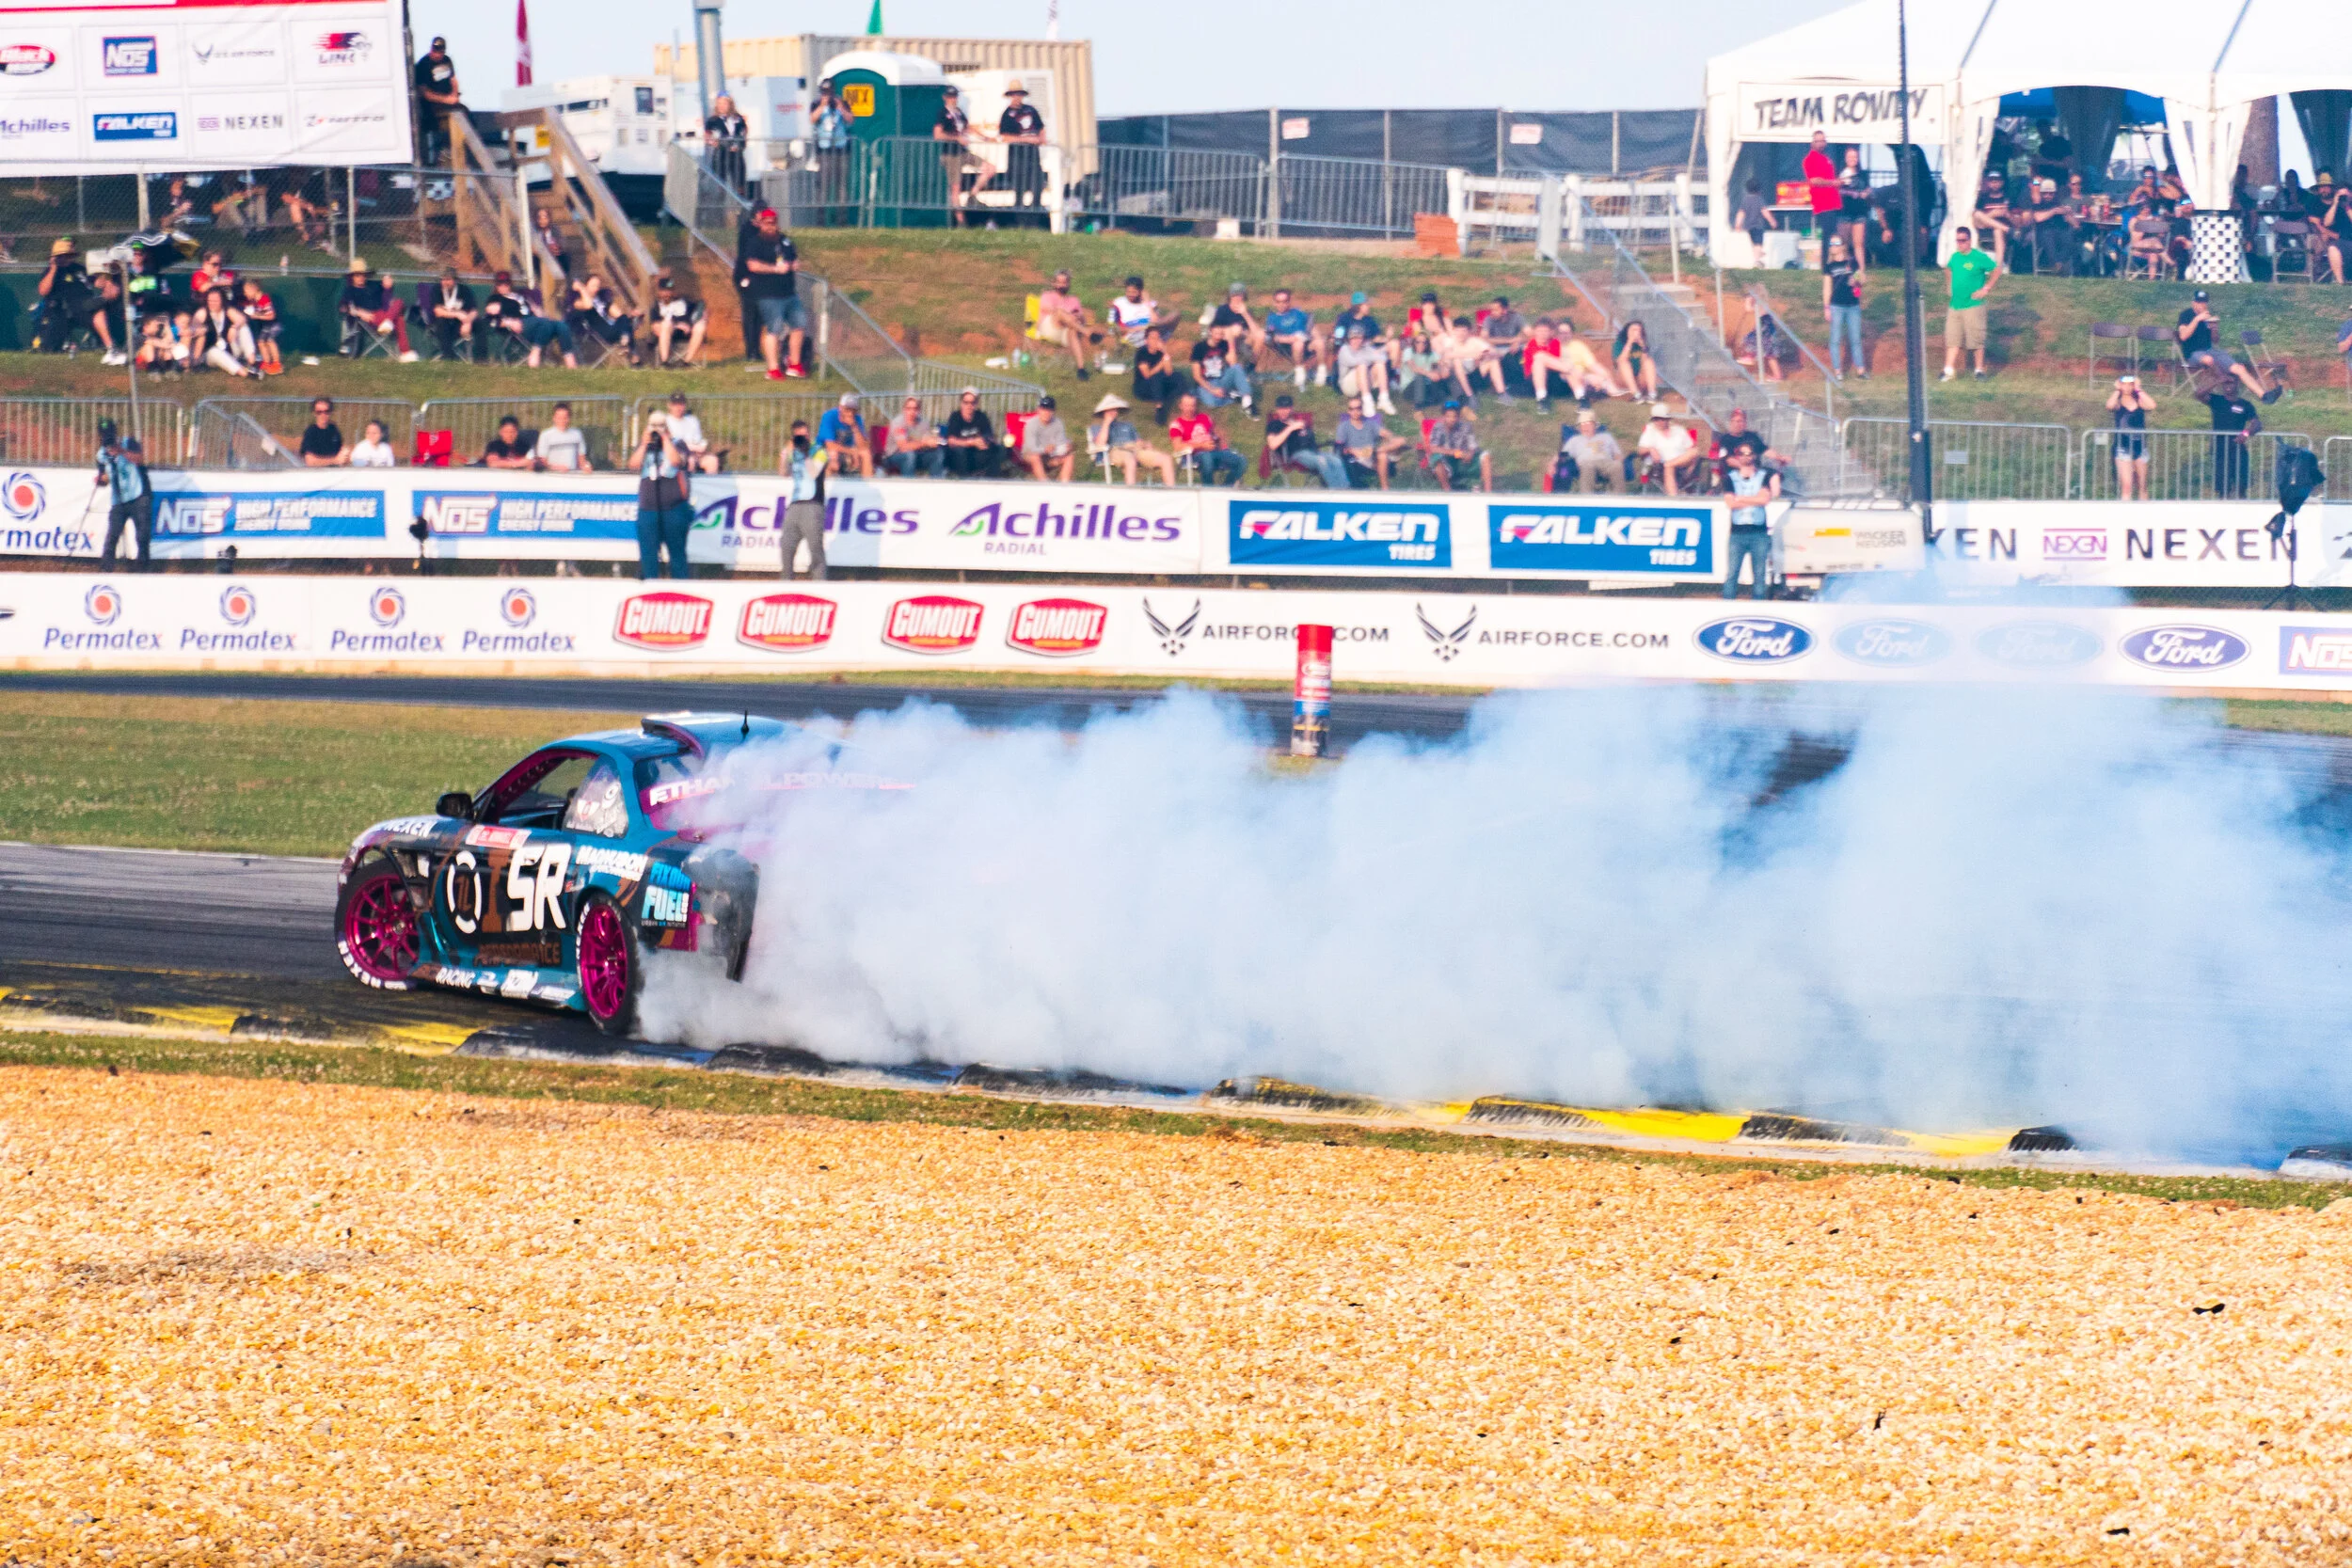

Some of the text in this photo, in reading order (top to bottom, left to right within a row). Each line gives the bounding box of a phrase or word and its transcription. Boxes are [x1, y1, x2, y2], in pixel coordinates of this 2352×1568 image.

[225, 116, 283, 130] NEXEN
[1755, 97, 1824, 130] TEAM
[156, 496, 232, 534] NOS
[272, 498, 377, 517] PERFORMANCE
[423, 494, 498, 533] NOS
[948, 502, 1182, 542] Achilles
[1239, 511, 1439, 542] FALKEN
[1499, 515, 1701, 546] FALKEN
[2043, 535, 2106, 554] NEXEN
[2126, 529, 2296, 561] NEXEN
[984, 542, 1047, 556] RADIAL
[1389, 544, 1436, 561] TIRES
[1649, 549, 1696, 565] TIRES
[624, 598, 709, 635] GUMOUT
[745, 600, 834, 637] GUMOUT
[891, 601, 980, 639] GUMOUT
[1015, 604, 1104, 641] GUMOUT
[43, 627, 163, 650] Permatex
[180, 628, 296, 651] Permatex
[330, 630, 445, 653] Permatex
[463, 630, 577, 653] Permatex
[1478, 630, 1669, 649] AIRFORCE.COM
[1716, 620, 1794, 657] Ford
[1854, 625, 1930, 657] Ford
[2144, 628, 2227, 664] Ford
